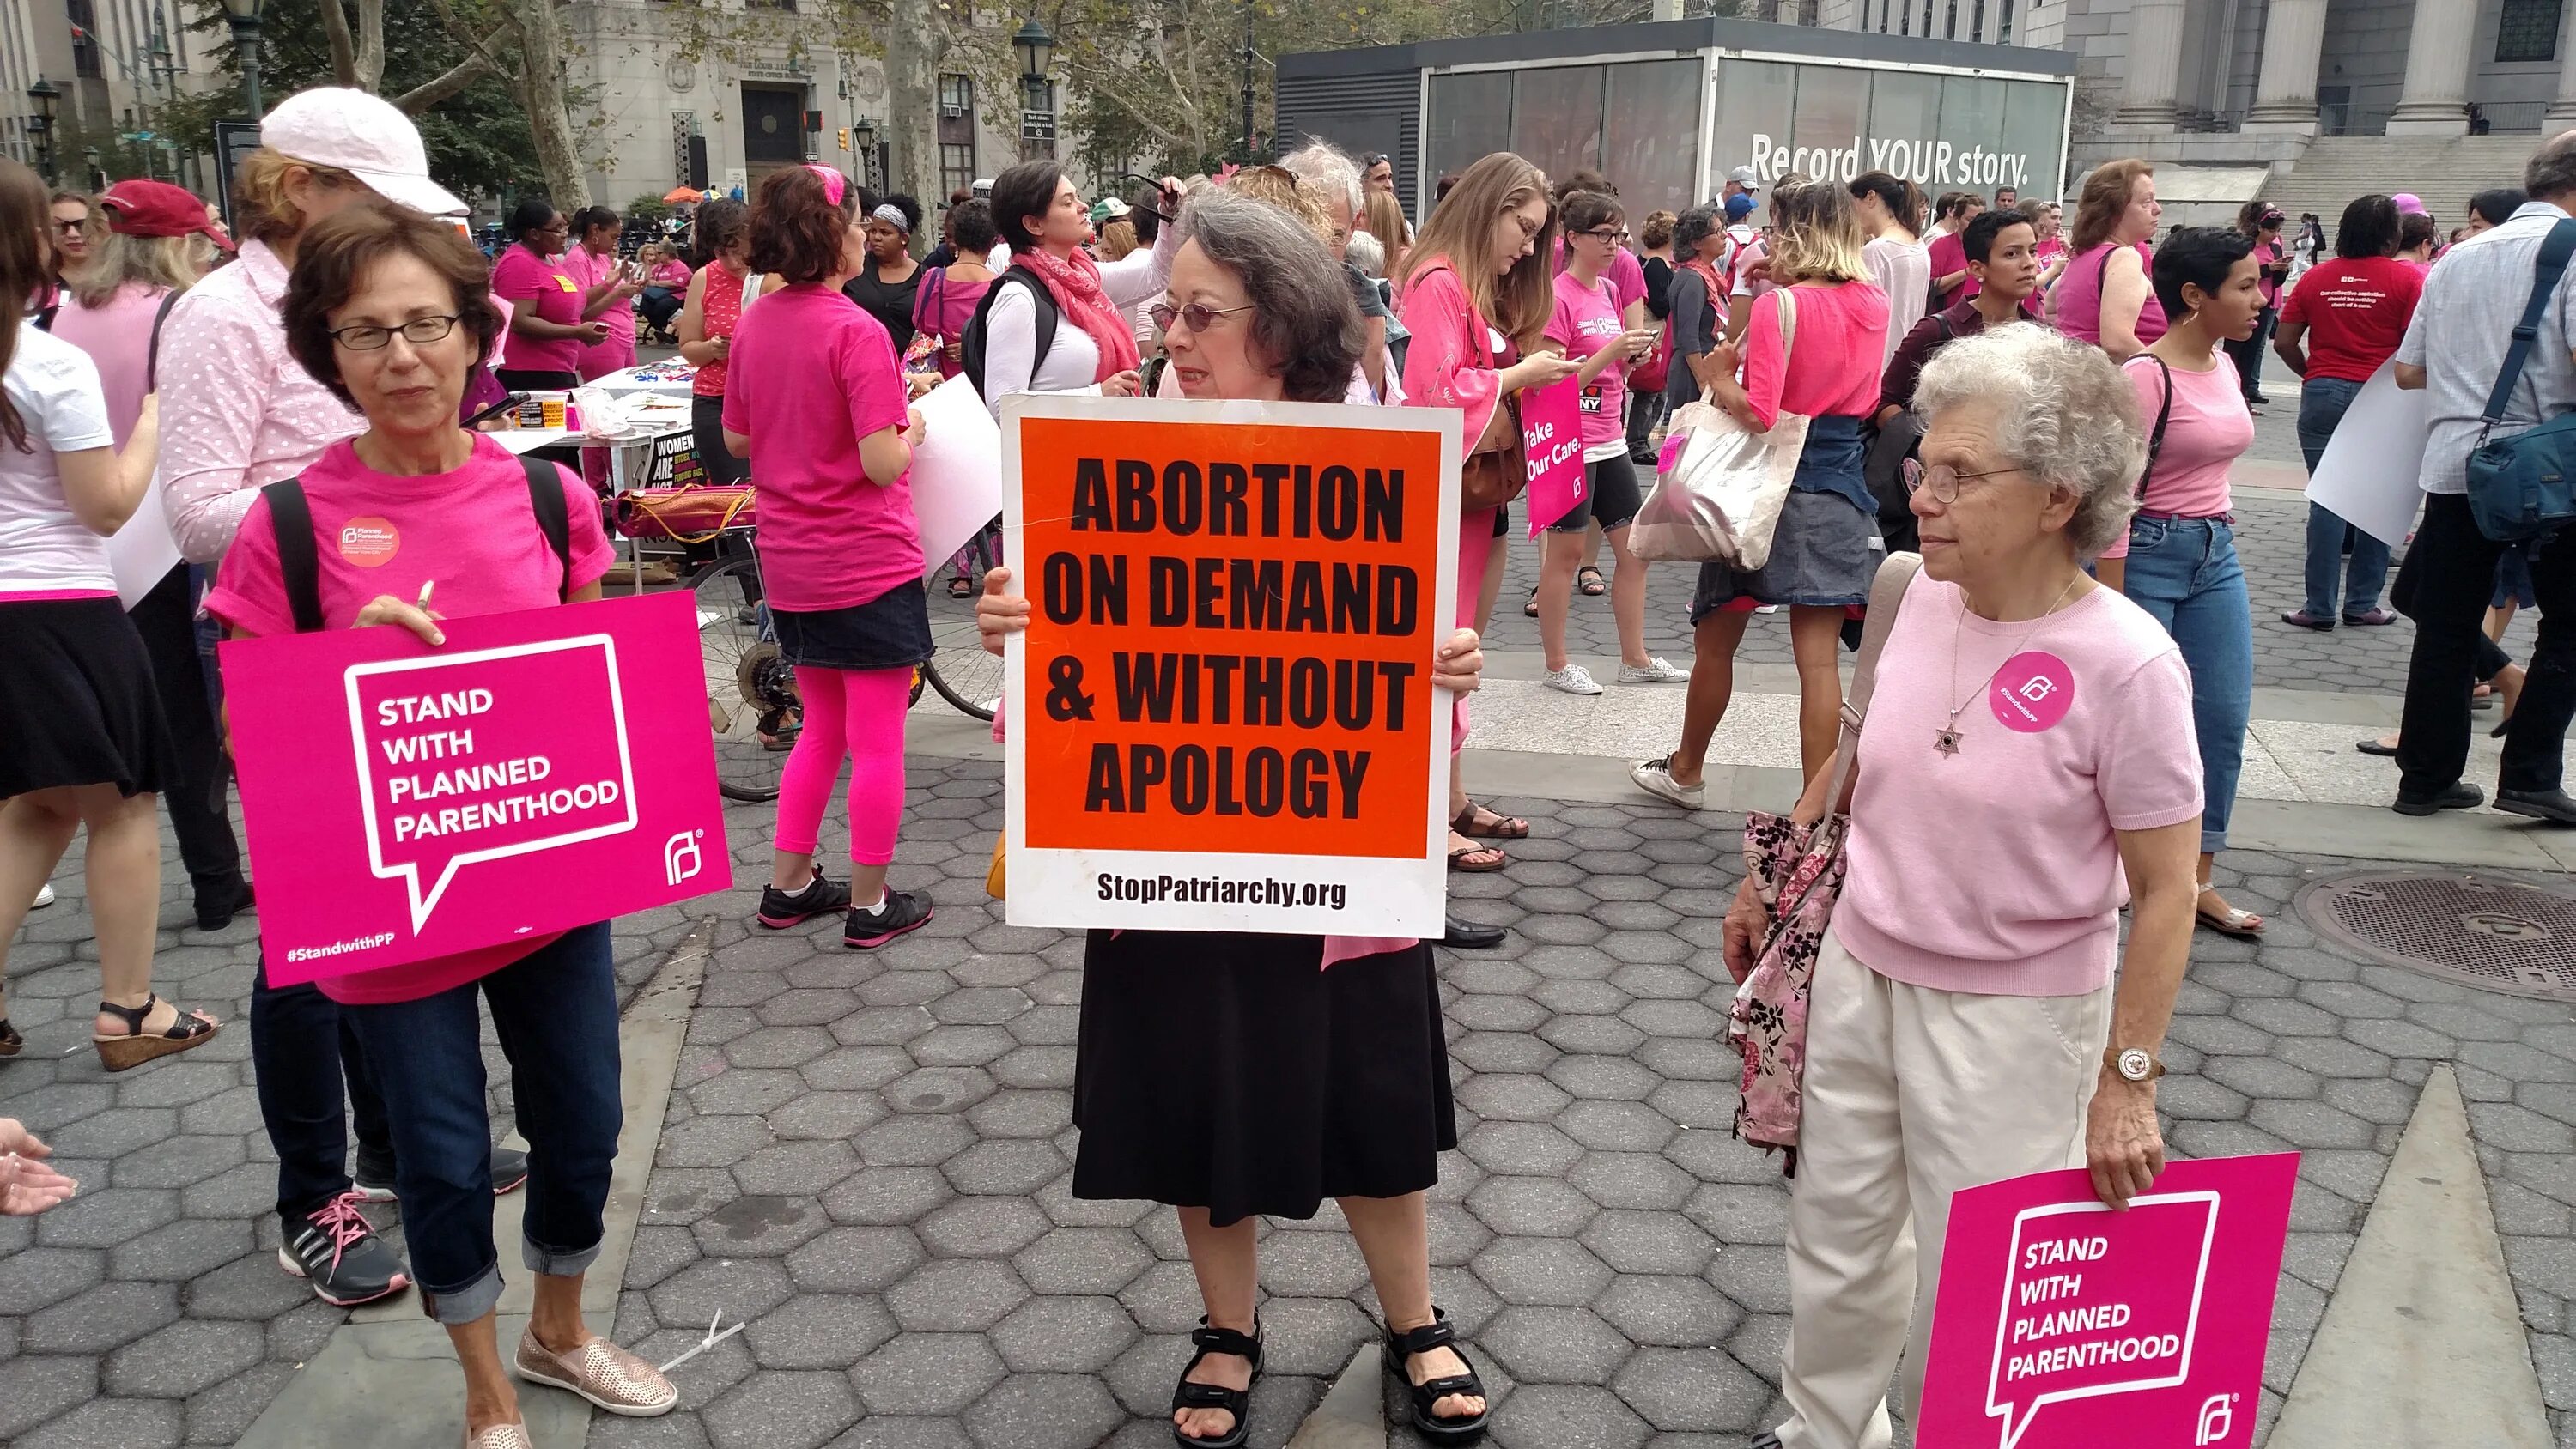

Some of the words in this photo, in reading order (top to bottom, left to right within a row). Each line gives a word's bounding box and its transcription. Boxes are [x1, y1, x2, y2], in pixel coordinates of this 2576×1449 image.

[755, 61, 773, 70] LOUIS
[1751, 133, 1861, 183] Record
[1869, 138, 1952, 185] YOUR
[1956, 143, 2028, 189] story.
[1577, 319, 1595, 330] Stand
[1582, 326, 1597, 336] With
[1580, 398, 1601, 409] NY
[657, 434, 695, 457] WOMEN
[1524, 421, 1554, 452] Take
[653, 457, 673, 481] ARE
[1528, 455, 1551, 481] Our
[1552, 436, 1582, 465] Care.
[1070, 458, 1405, 543] ABORTION
[1042, 551, 1128, 626] ON
[1149, 555, 1419, 636] DEMAND
[378, 688, 494, 727] STAND
[1045, 655, 1095, 723] &
[1111, 651, 1415, 732] WITHOUT
[2001, 688, 2038, 723] #StandwithPP
[381, 728, 474, 765] WITH
[388, 755, 550, 804] PLANNED
[1084, 743, 1372, 820] APOLOGY
[393, 779, 618, 842] PARENTHOOD
[1097, 872, 1346, 910] StopPatriarchy.org
[287, 932, 395, 963] #StandwithPP
[2023, 1236, 2108, 1270] STAND
[2020, 1273, 2082, 1307] WITH
[2012, 1303, 2131, 1345] PLANNED
[2007, 1334, 2179, 1383] PARENTHOOD
